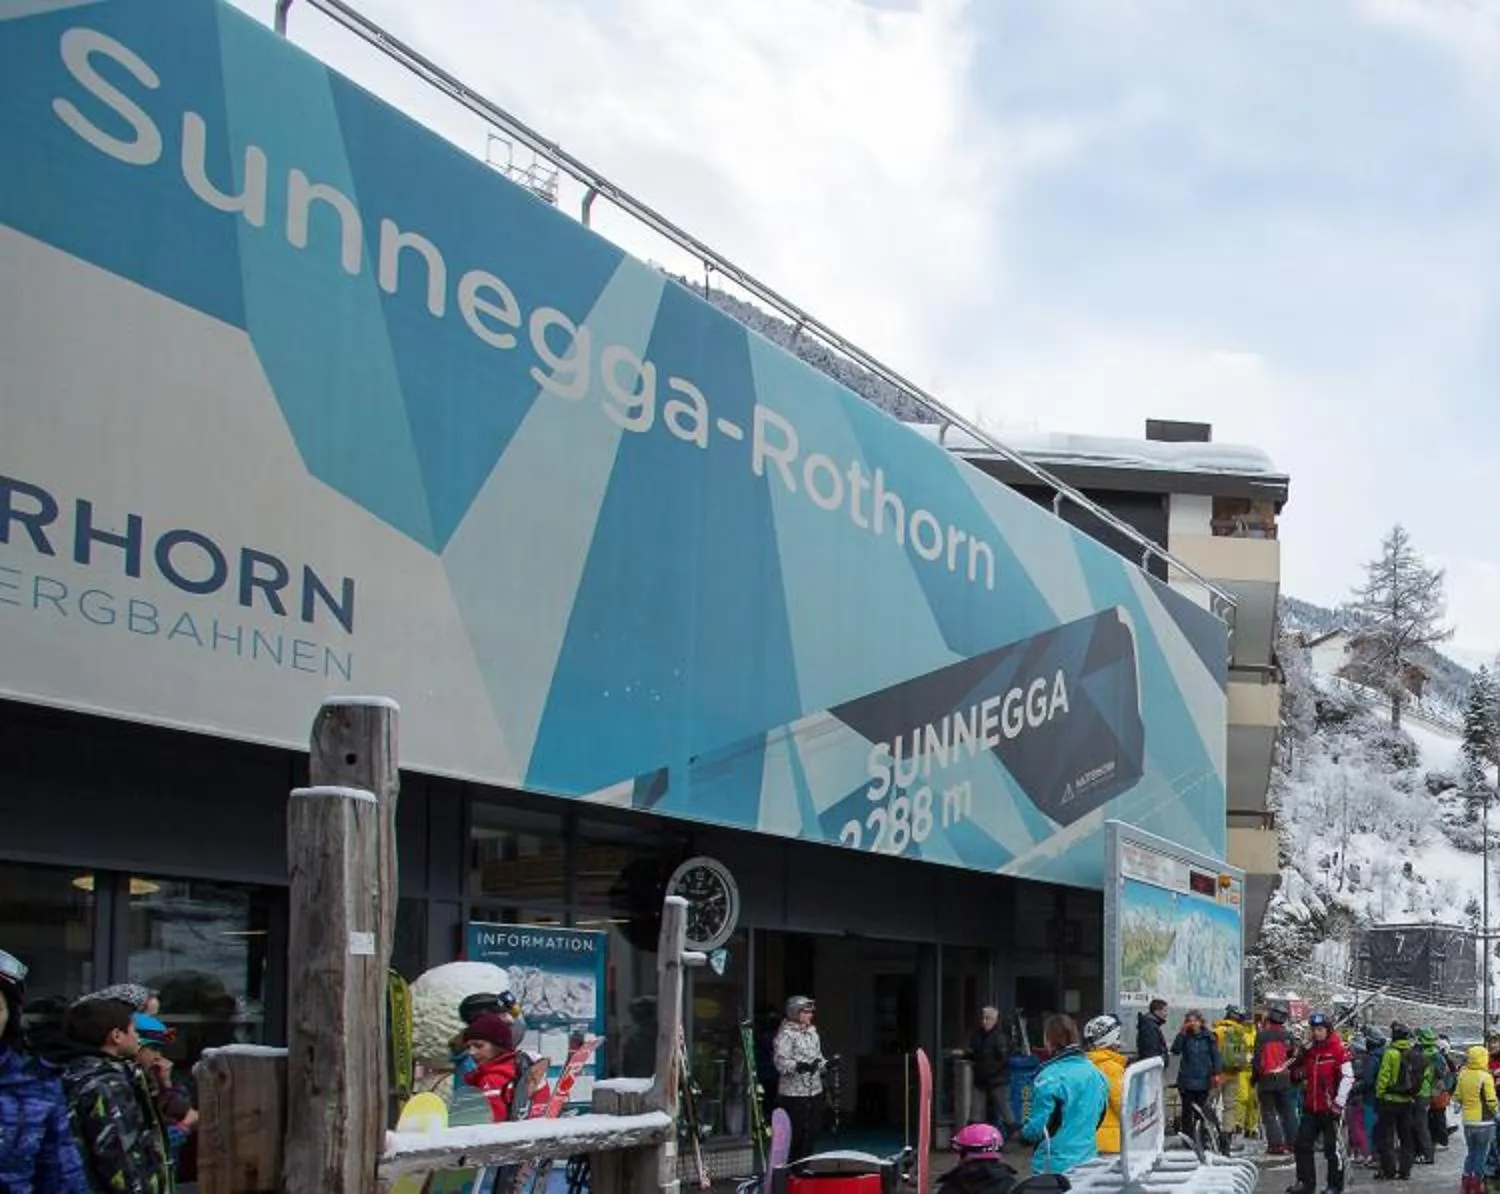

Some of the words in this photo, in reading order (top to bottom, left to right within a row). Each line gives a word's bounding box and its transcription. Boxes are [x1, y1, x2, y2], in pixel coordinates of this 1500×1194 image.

[52, 27, 995, 591] Sunnegga-Rothorn
[0, 475, 355, 635] RHORN
[867, 669, 1069, 801] SUNNEGGA
[942, 781, 973, 828] m
[476, 932, 594, 952] INFORMATION
